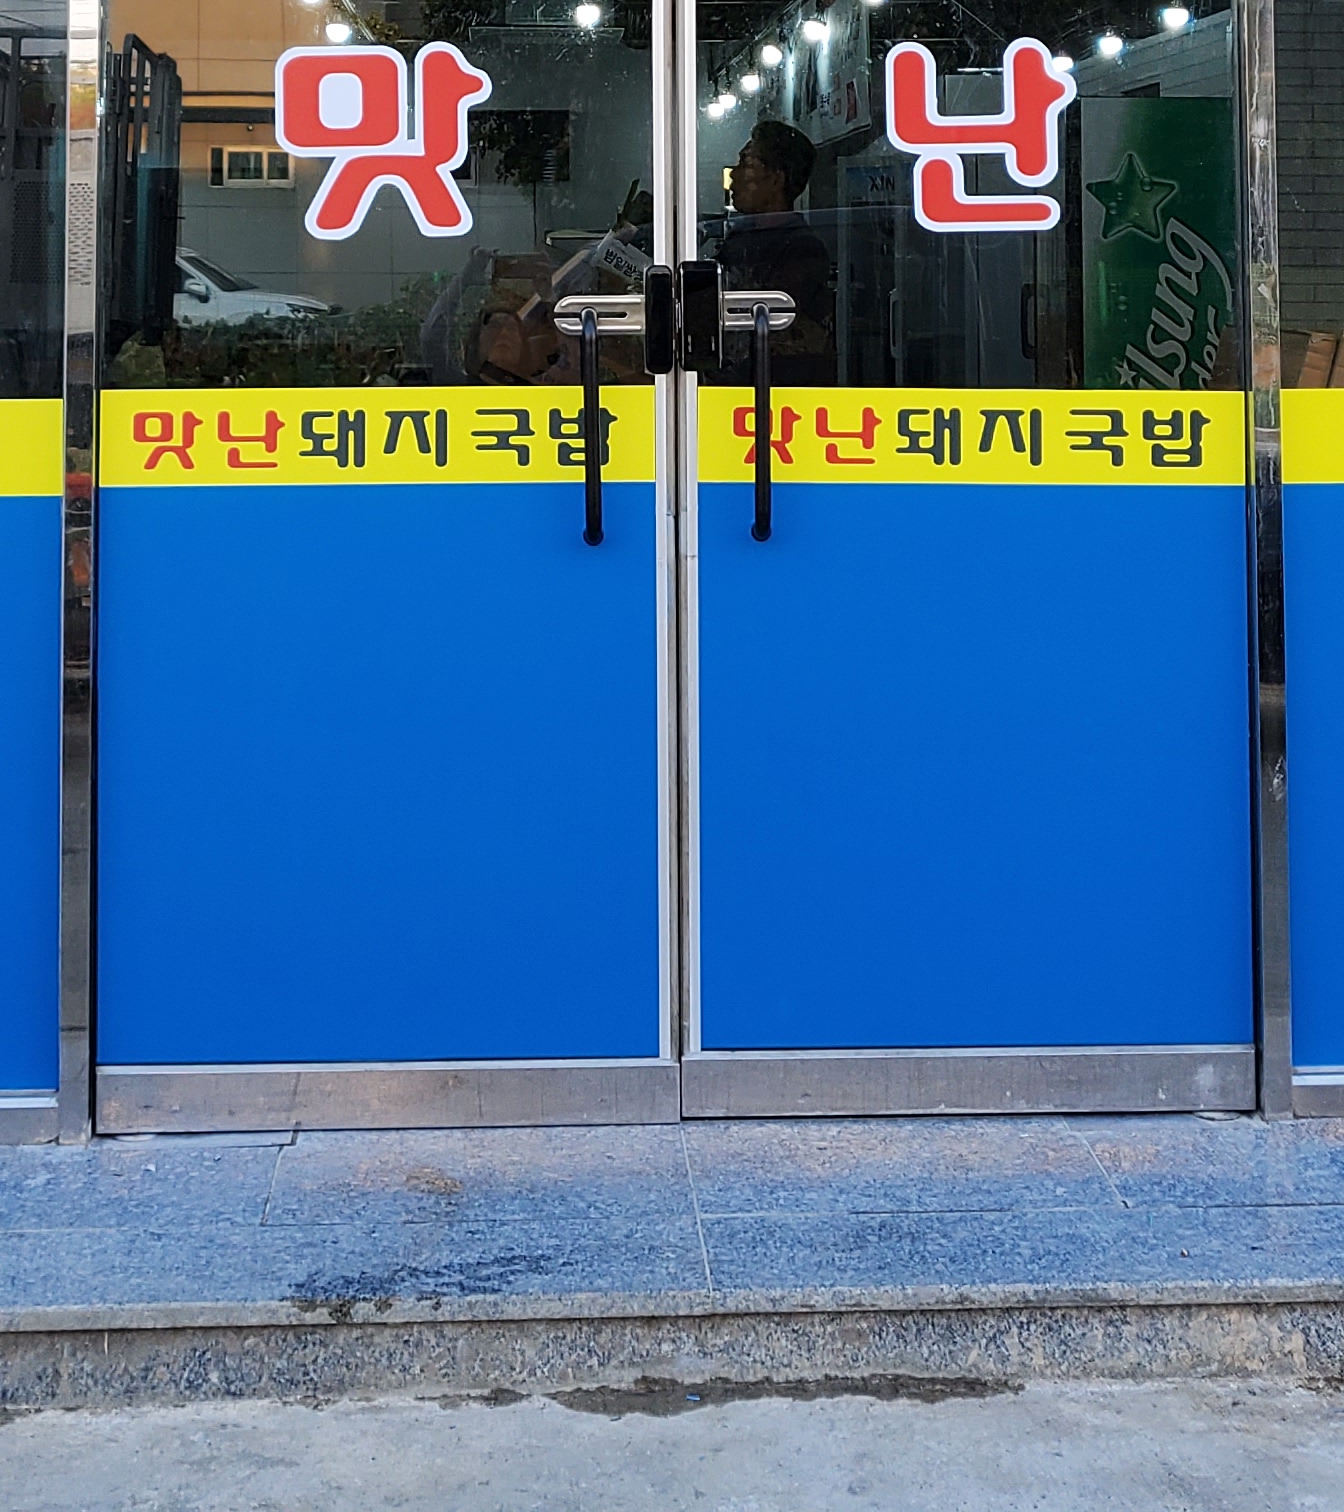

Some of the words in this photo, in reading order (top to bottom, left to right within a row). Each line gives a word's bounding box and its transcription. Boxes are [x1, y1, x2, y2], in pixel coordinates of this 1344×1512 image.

[275, 41, 493, 239] 맛
[886, 37, 1076, 232] 난
[132, 407, 619, 470] 맛난돼지국밥
[732, 405, 1212, 469] 맛난돼지국밥
